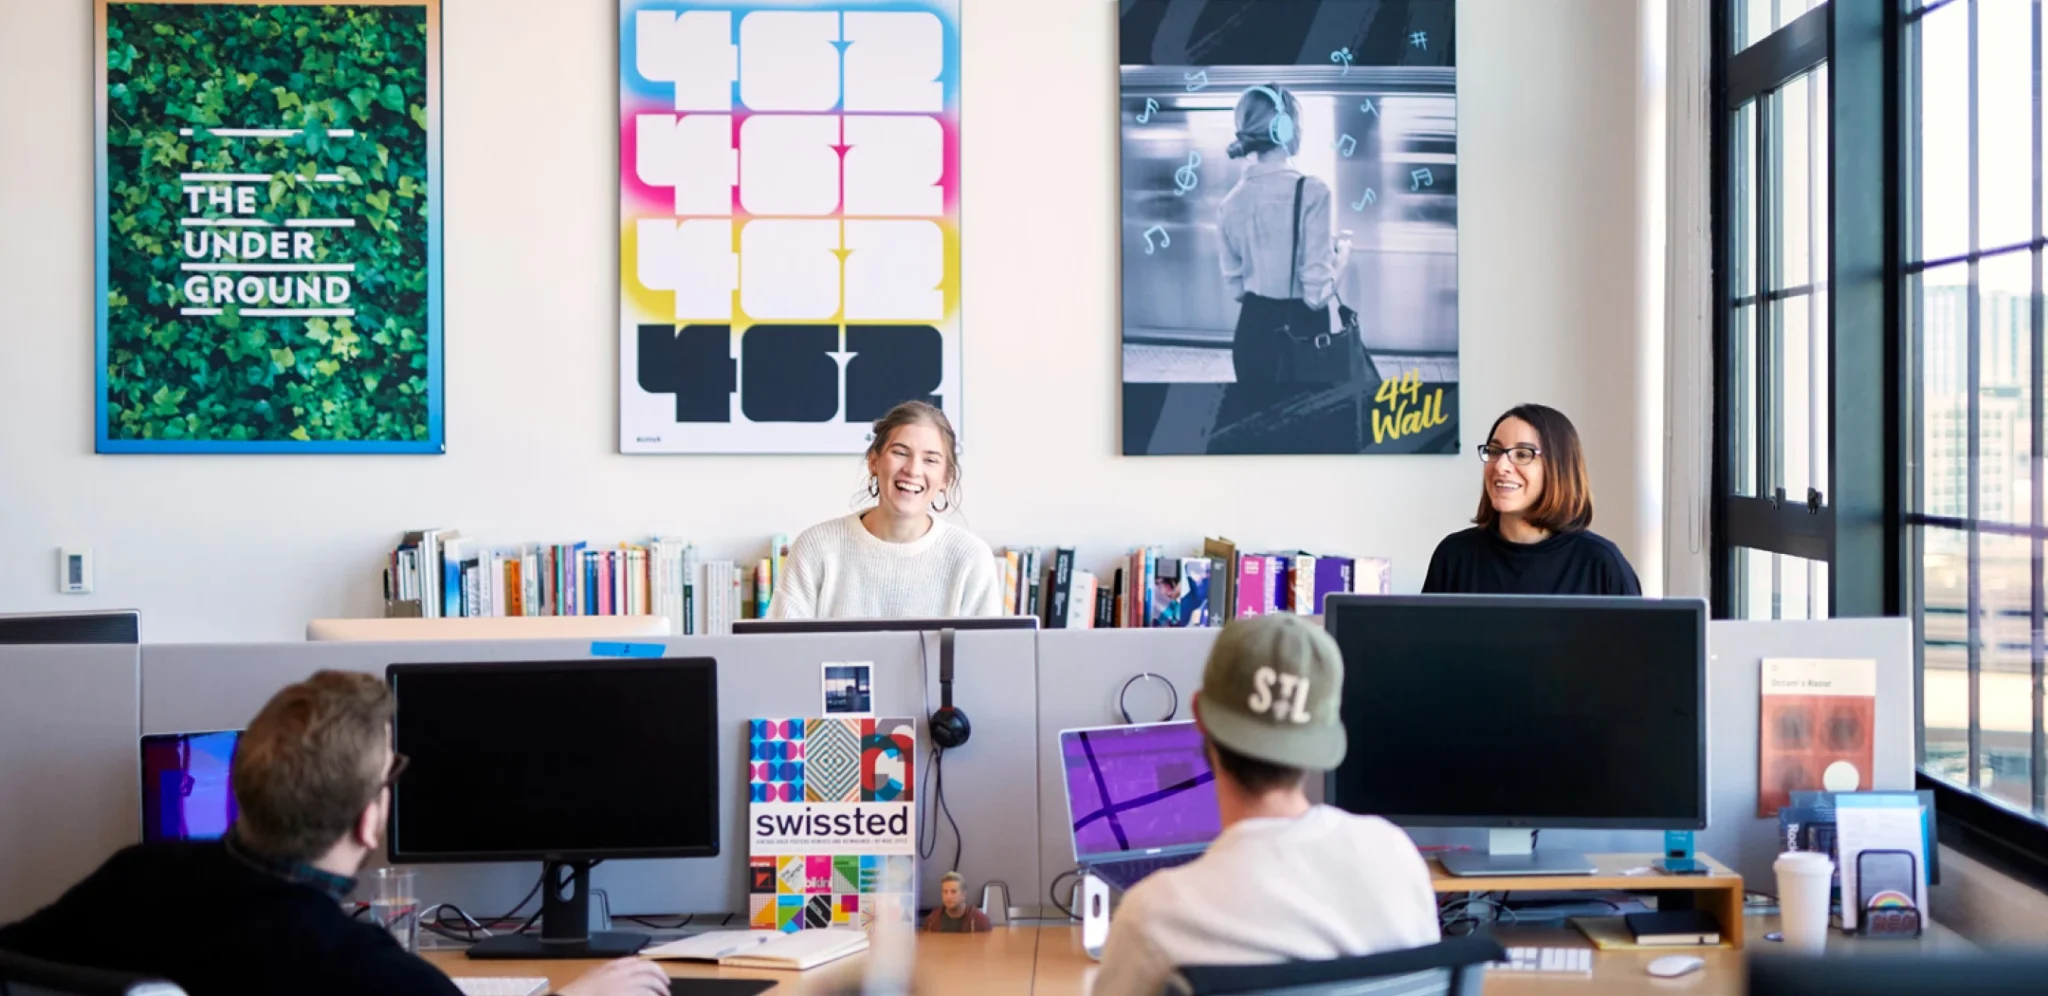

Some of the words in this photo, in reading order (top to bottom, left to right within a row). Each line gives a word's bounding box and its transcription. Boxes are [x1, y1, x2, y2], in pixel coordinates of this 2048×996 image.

[183, 186, 256, 214] THE
[184, 231, 315, 259] UNDER
[184, 276, 350, 304] GROUND
[1374, 368, 1424, 412] 44
[1371, 388, 1449, 444] Wall
[1247, 665, 1312, 724] STL
[756, 805, 908, 837] swissted
